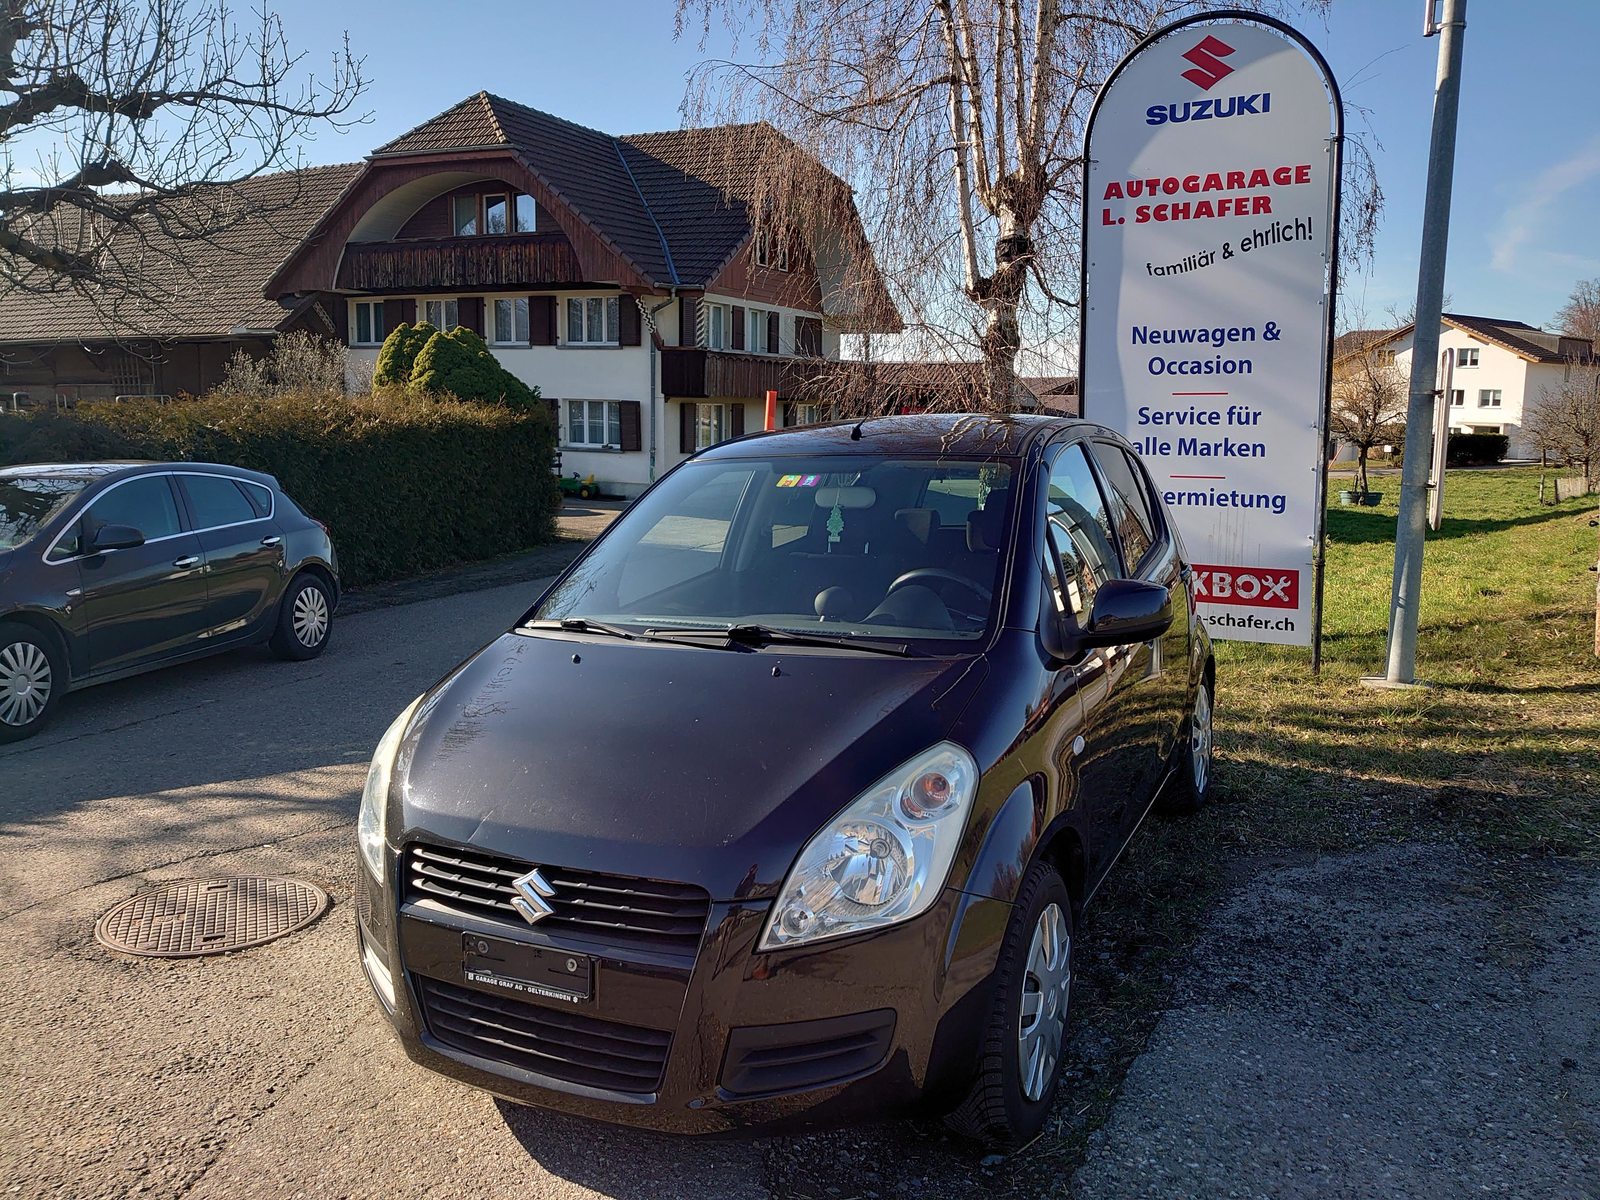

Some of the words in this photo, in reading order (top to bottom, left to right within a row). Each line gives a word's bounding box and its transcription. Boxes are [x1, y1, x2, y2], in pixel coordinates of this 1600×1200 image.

[1145, 92, 1271, 126] SUZUKI
[1103, 164, 1312, 200] AUTOGARAGE
[1102, 208, 1125, 226] L.
[1135, 195, 1272, 224] SCHAFER
[1146, 250, 1216, 277] familiär
[1222, 242, 1234, 260] &
[1240, 216, 1313, 253] ehrlich!
[1131, 325, 1256, 347] Neuwagen
[1263, 321, 1281, 341] &
[1148, 355, 1253, 375] Occasion
[1137, 406, 1221, 426] Service
[1226, 406, 1262, 425] für
[1133, 437, 1171, 456] alle
[1177, 438, 1266, 458] Marken
[1161, 487, 1286, 514] ermietung
[475, 975, 498, 985] GARAGE
[498, 980, 514, 989] GRAF
